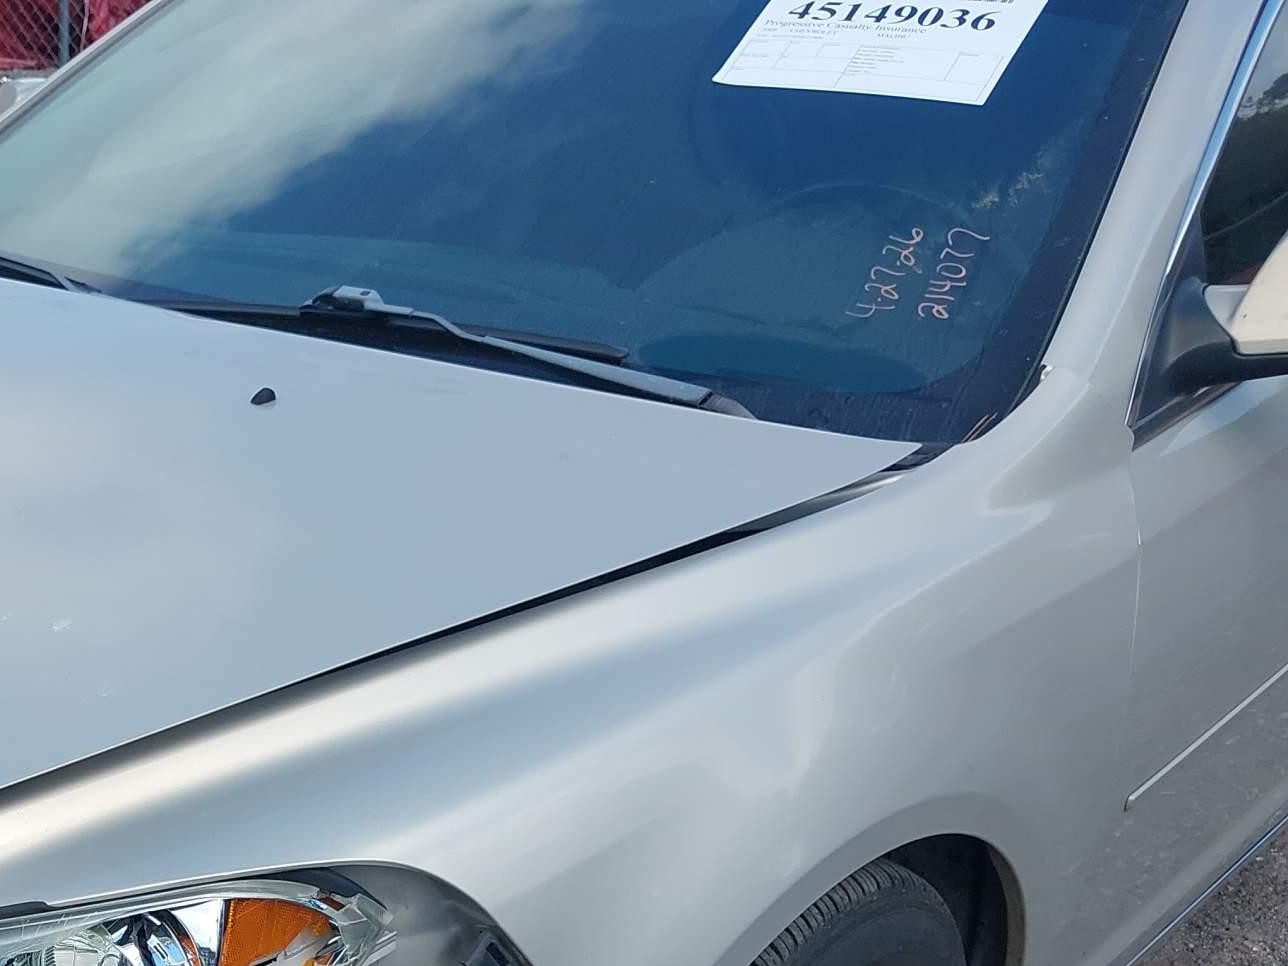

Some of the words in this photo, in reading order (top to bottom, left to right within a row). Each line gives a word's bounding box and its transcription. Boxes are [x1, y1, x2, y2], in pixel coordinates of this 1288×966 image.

[765, 19, 824, 28] Progressive
[826, 22, 871, 31] Casualty
[875, 24, 927, 34] Insurance
[787, 1, 1002, 31] 45149036
